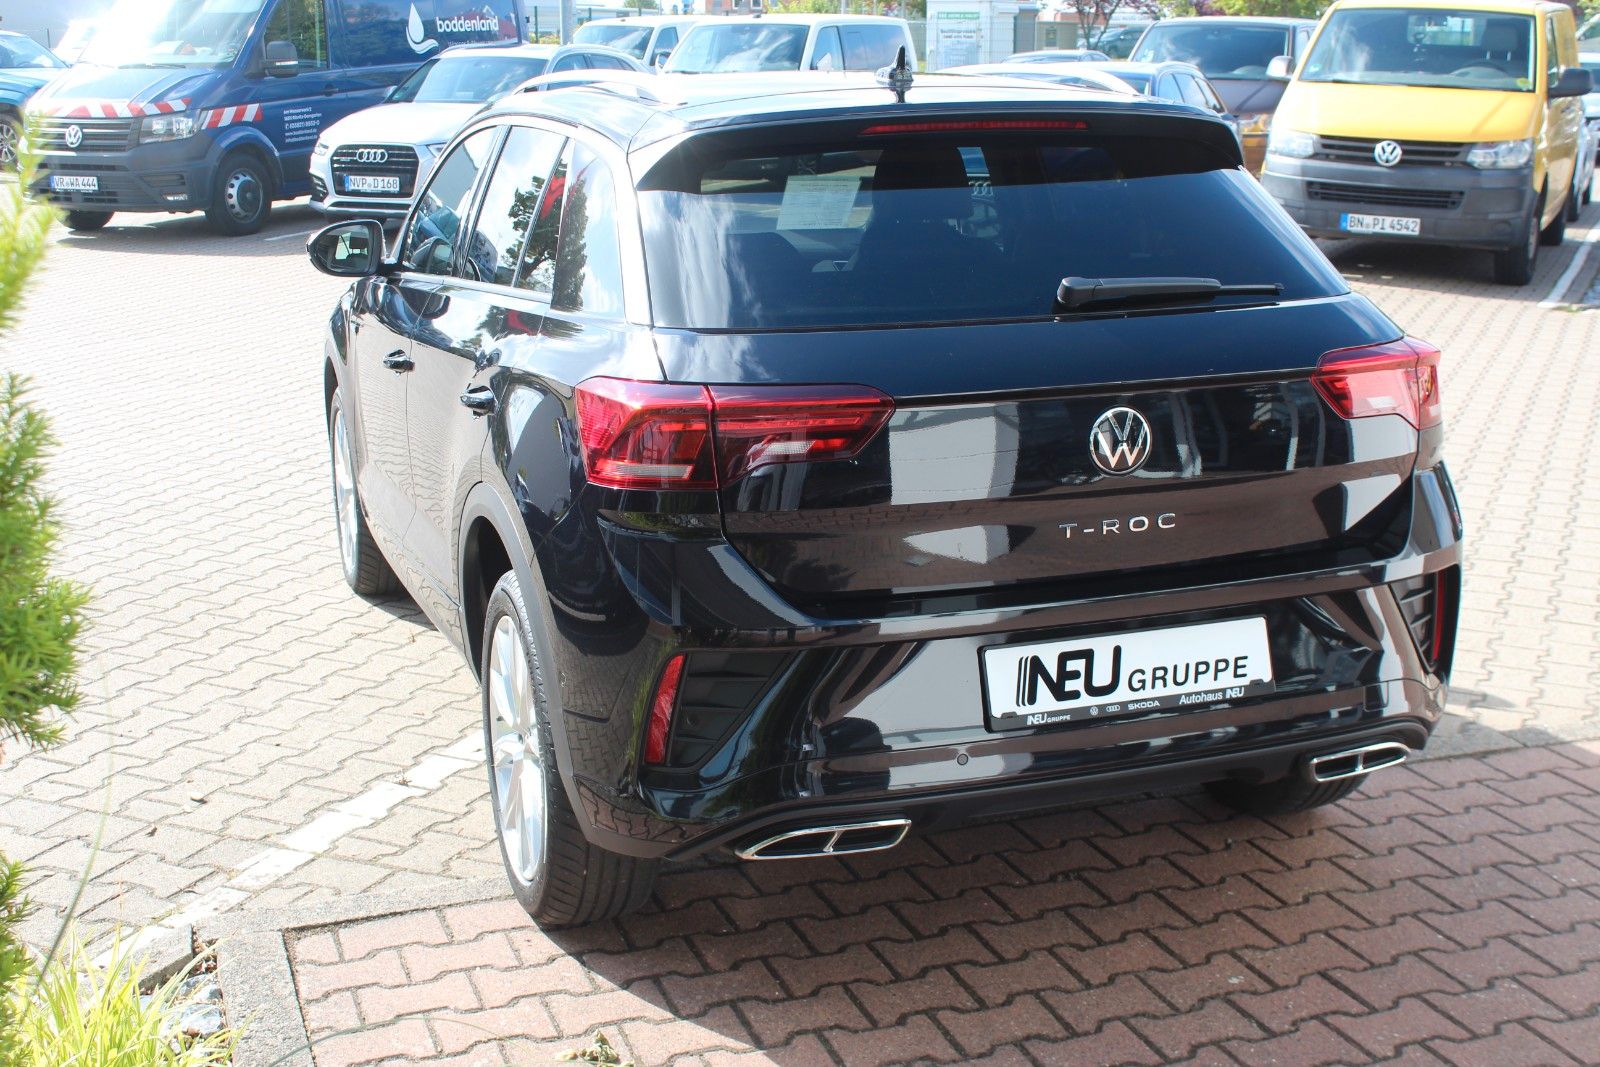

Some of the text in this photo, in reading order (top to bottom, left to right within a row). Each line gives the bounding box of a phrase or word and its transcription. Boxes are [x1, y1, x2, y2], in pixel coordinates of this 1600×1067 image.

[436, 16, 499, 32] boddenland
[55, 177, 96, 188] VR WA 444
[350, 177, 398, 189] NVP D 168
[1349, 216, 1418, 233] BN PI 4542
[1090, 406, 1151, 475] VW
[1059, 512, 1176, 539] T-ROC
[1016, 644, 1249, 707] NEU GRUPPE
[1179, 686, 1245, 705] Autohaus NEU
[1026, 712, 1071, 726] NEU GRUPPE
